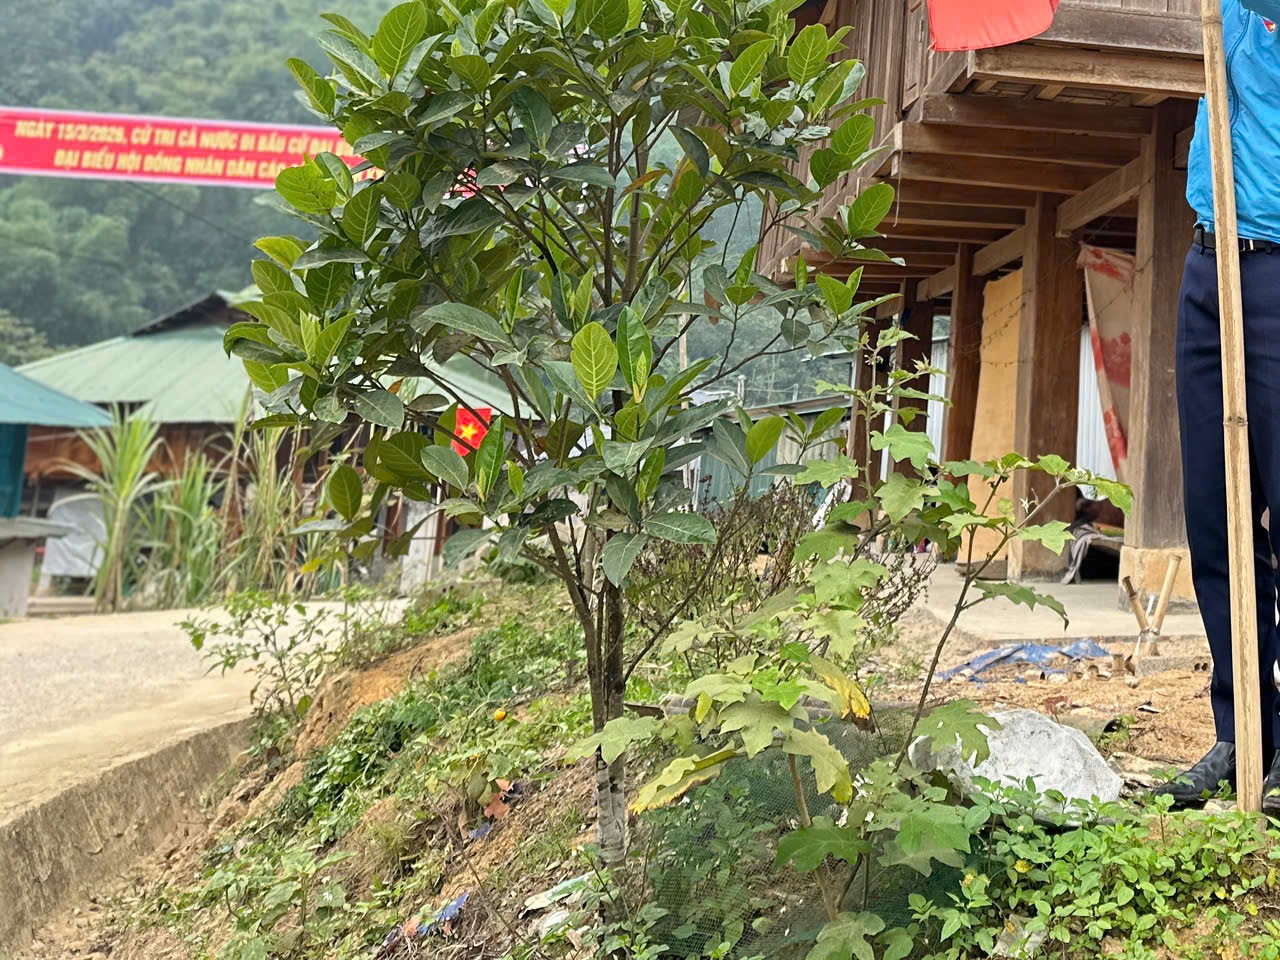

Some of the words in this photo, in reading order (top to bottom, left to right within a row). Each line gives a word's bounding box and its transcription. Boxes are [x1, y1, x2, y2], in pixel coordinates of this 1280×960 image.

[15, 117, 55, 139] NGÀY
[130, 123, 153, 145] CỬ
[154, 128, 177, 146] TRI
[177, 126, 198, 148] CẢ
[53, 149, 80, 171] ĐẠI
[116, 150, 142, 175] HỘI
[183, 155, 225, 177] NHÂN
[225, 157, 257, 178] DÂN
